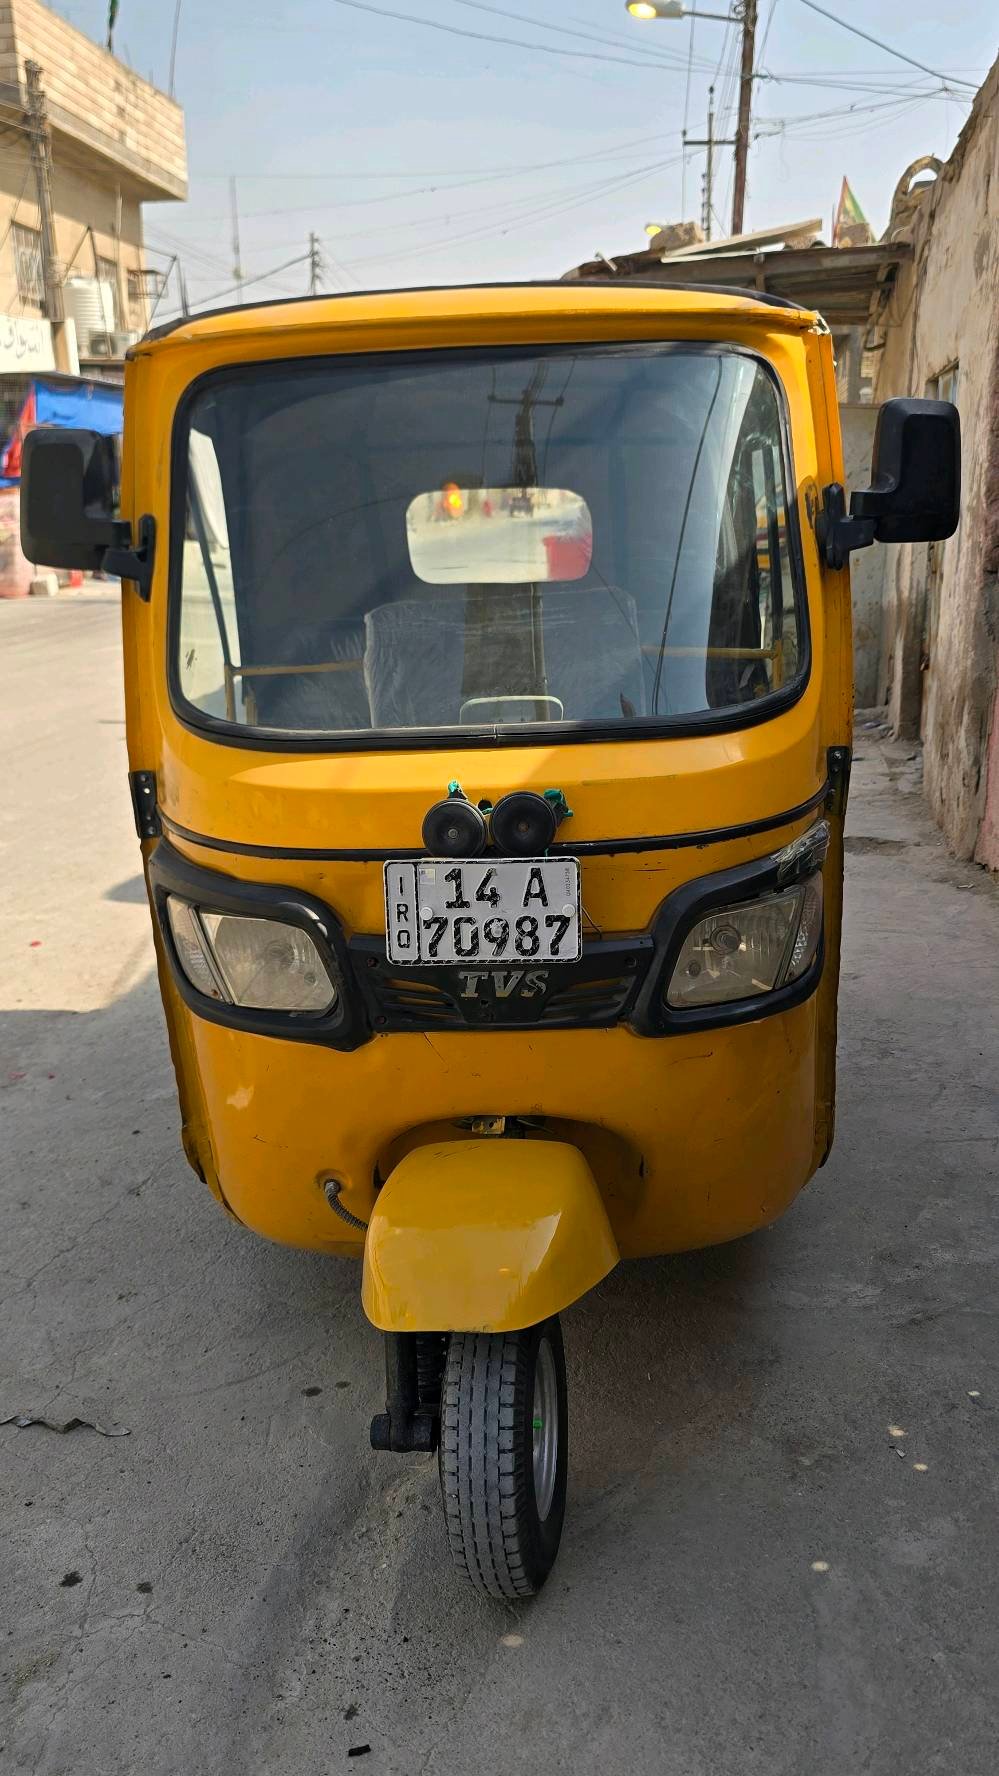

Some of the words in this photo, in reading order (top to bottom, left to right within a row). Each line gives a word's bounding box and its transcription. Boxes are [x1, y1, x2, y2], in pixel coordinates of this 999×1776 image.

[445, 867, 501, 909] 14
[521, 867, 549, 907] A
[396, 876, 411, 949] IRQ
[423, 914, 571, 957] 70987
[458, 970, 549, 998] TVS
